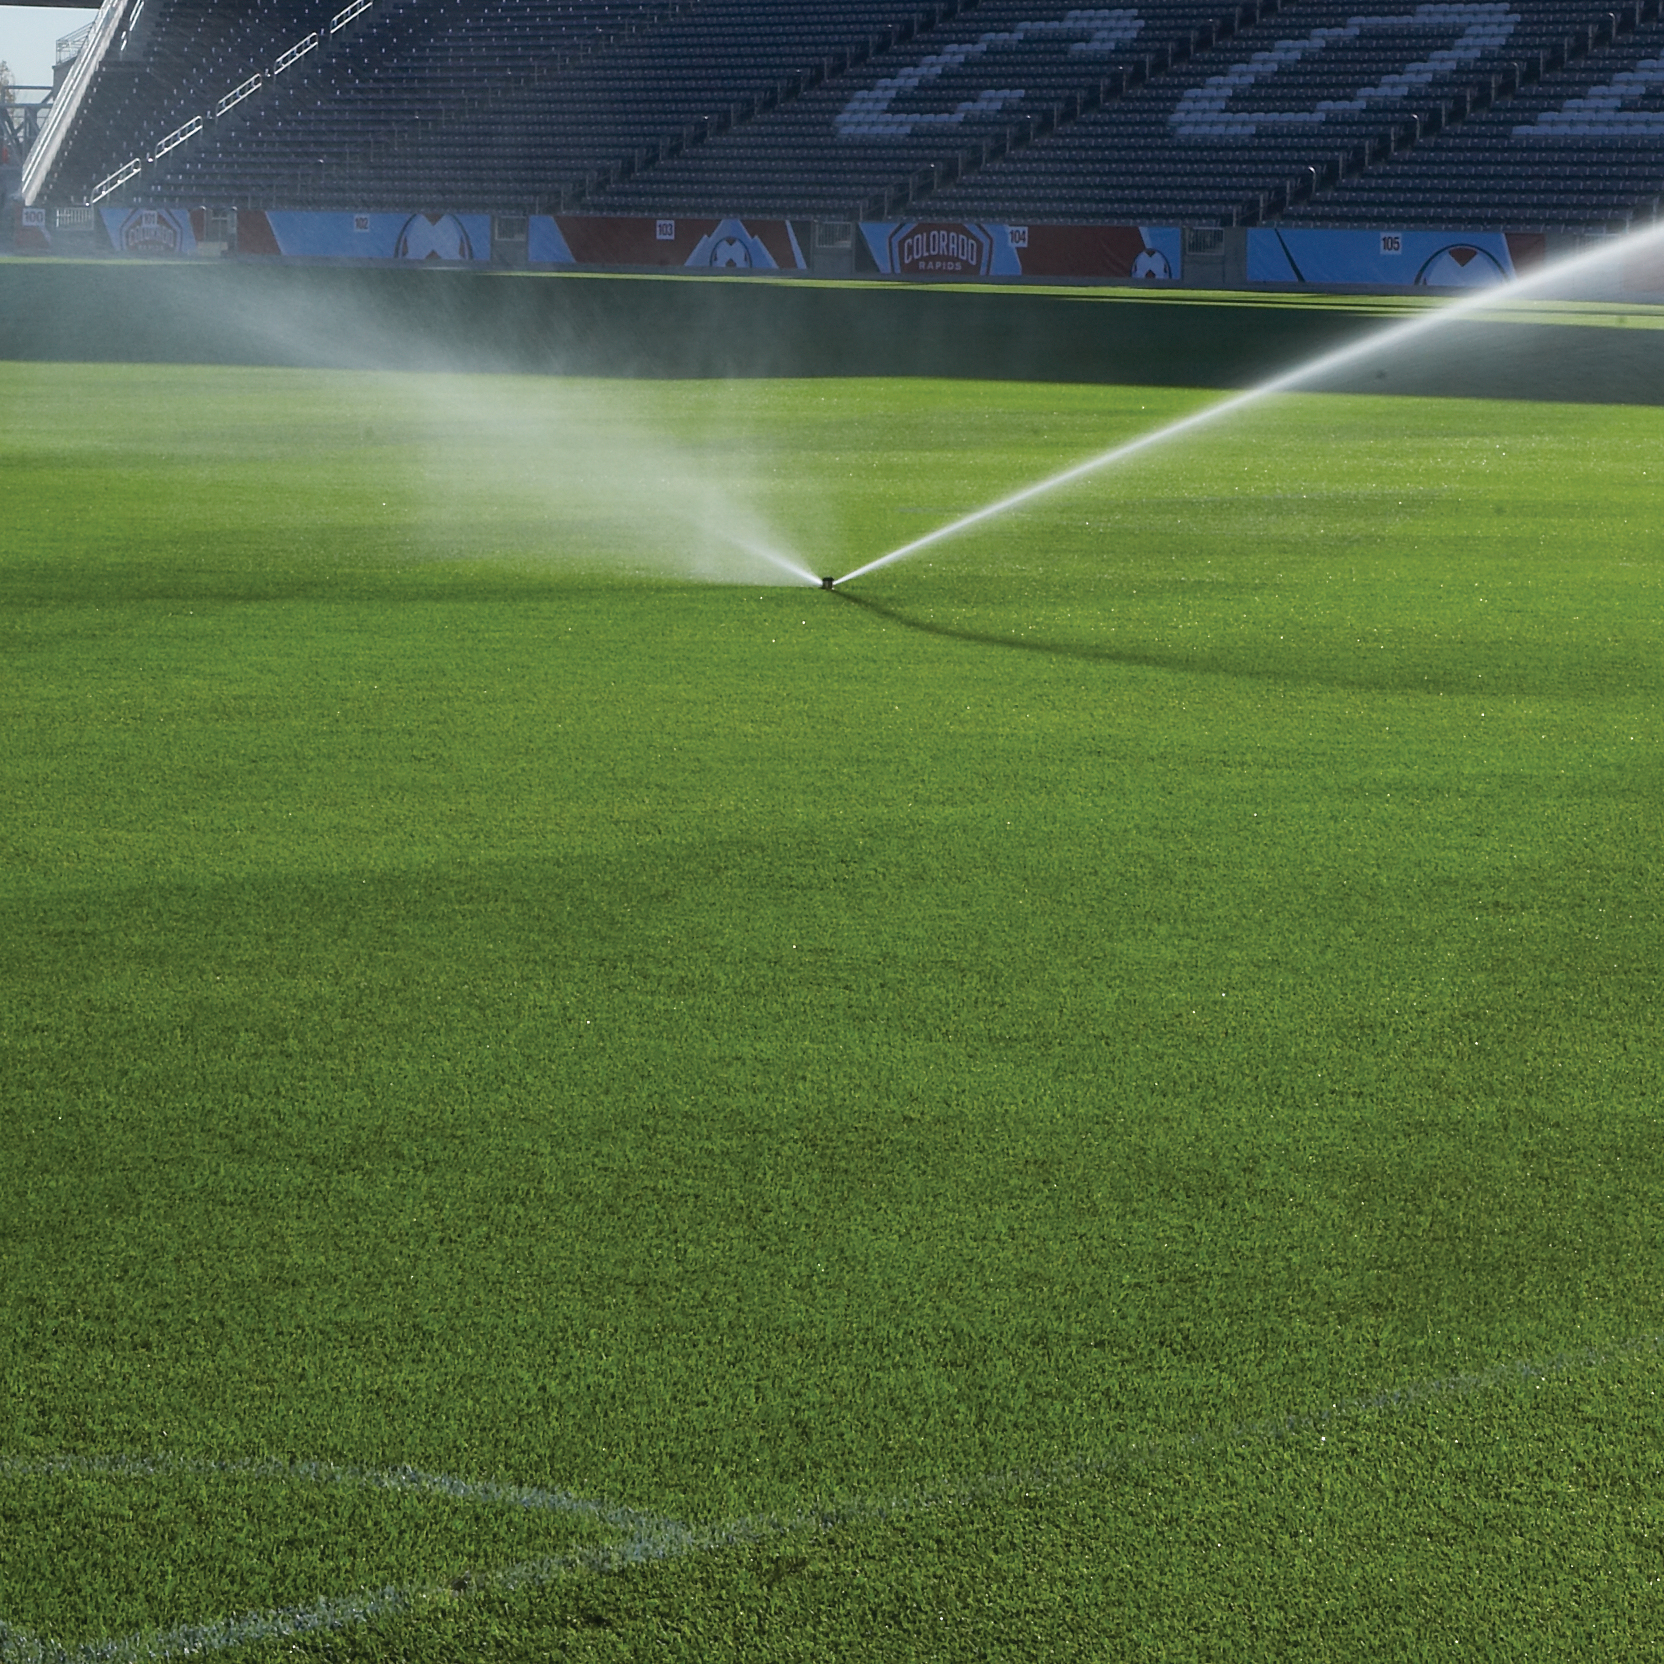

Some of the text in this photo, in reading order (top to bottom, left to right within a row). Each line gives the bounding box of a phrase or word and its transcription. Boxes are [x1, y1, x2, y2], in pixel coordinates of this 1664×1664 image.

[24, 210, 44, 223] 100
[658, 223, 673, 236] 103
[1009, 229, 1026, 244] 104
[904, 230, 977, 266] COLORADO
[1382, 236, 1400, 251] 105
[918, 261, 962, 271] RAPIDS
